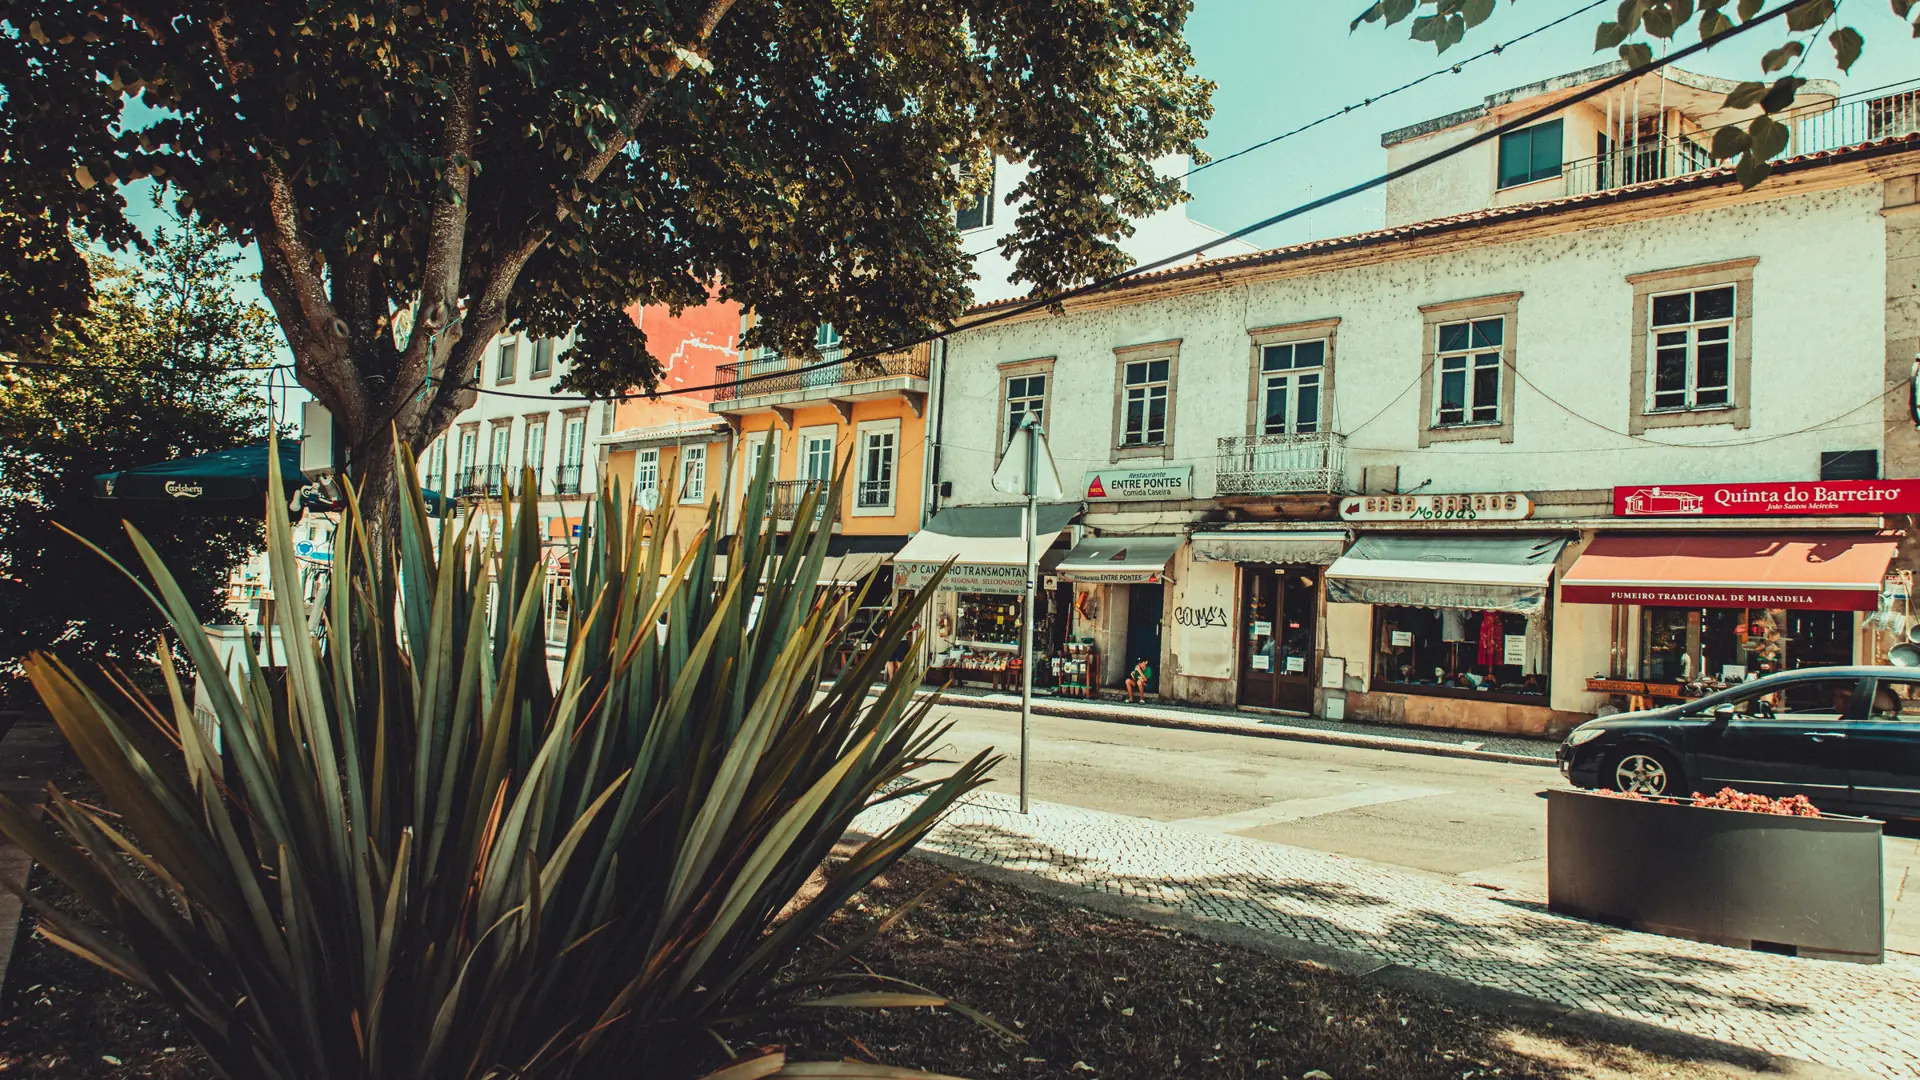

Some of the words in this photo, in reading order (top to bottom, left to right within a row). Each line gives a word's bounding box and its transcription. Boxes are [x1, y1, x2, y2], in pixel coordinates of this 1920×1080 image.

[1128, 471, 1167, 479] Restaurante
[164, 480, 204, 498] Carlsberg
[1111, 479, 1142, 490] ENTRE
[1143, 477, 1182, 489] PONTES
[1122, 489, 1147, 497] Comida
[1147, 488, 1172, 496] Caseira
[1714, 488, 1780, 508] Quinta
[1784, 486, 1810, 503] do
[1814, 486, 1898, 503] Barreiro
[1364, 497, 1417, 513] CASA
[1431, 494, 1518, 511] BARROS
[1765, 501, 1782, 512] João
[1783, 502, 1807, 511] Santos
[1808, 501, 1840, 510] Meireles
[911, 564, 918, 573] O
[920, 564, 962, 575] CANTHO
[951, 577, 979, 585] REGIONAIS
[982, 578, 1024, 587] SELECIONADOS
[1100, 574, 1119, 582] ENTRE
[1119, 574, 1143, 582] PONTES
[1362, 586, 1412, 604] Casa
[1611, 591, 1655, 601] FUMEIRO
[1657, 592, 1728, 602] TRADICIONAL
[1730, 593, 1745, 602] DE
[1747, 593, 1814, 604] MIRANDELA
